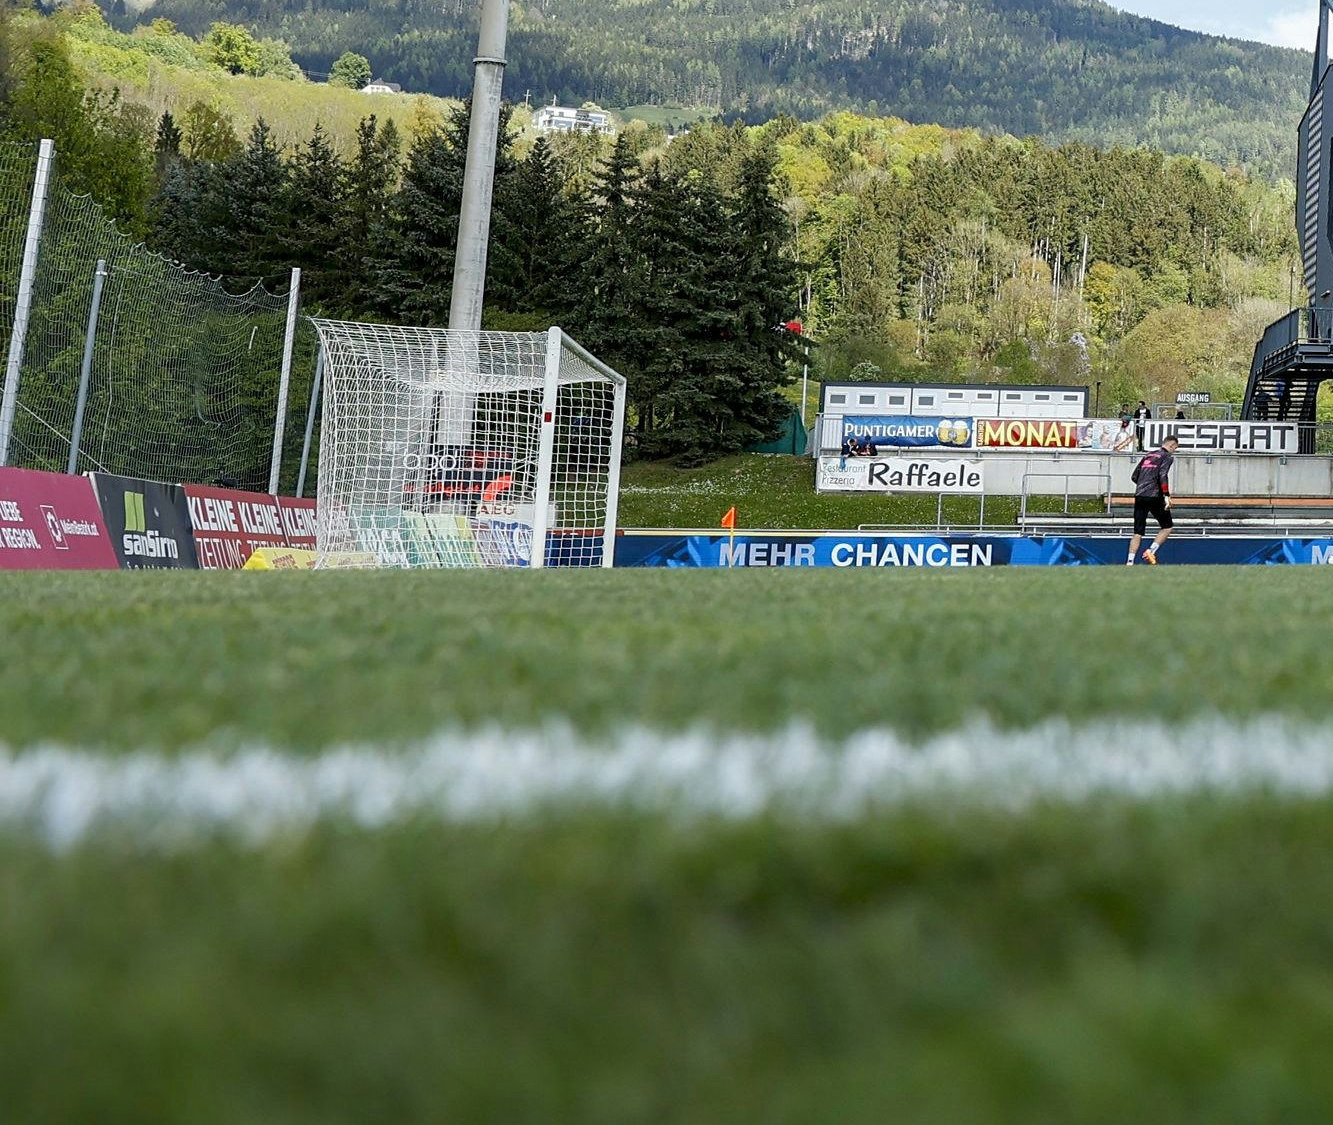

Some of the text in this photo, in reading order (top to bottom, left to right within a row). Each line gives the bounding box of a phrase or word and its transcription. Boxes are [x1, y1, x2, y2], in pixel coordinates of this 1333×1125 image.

[1177, 393, 1210, 403] AUSGANG
[844, 422, 934, 438] PUNTIGAMER
[984, 420, 1076, 447] MONAT
[1150, 423, 1294, 450] WESA.AT
[821, 474, 856, 485] Pizzeria
[868, 462, 980, 487] Raffaele
[187, 496, 239, 532] KLEINE
[238, 501, 282, 536] KLEINE
[2, 528, 42, 550] REGION.
[196, 537, 247, 570] ZEITUNG
[719, 543, 993, 567] MEHR CHANCEN
